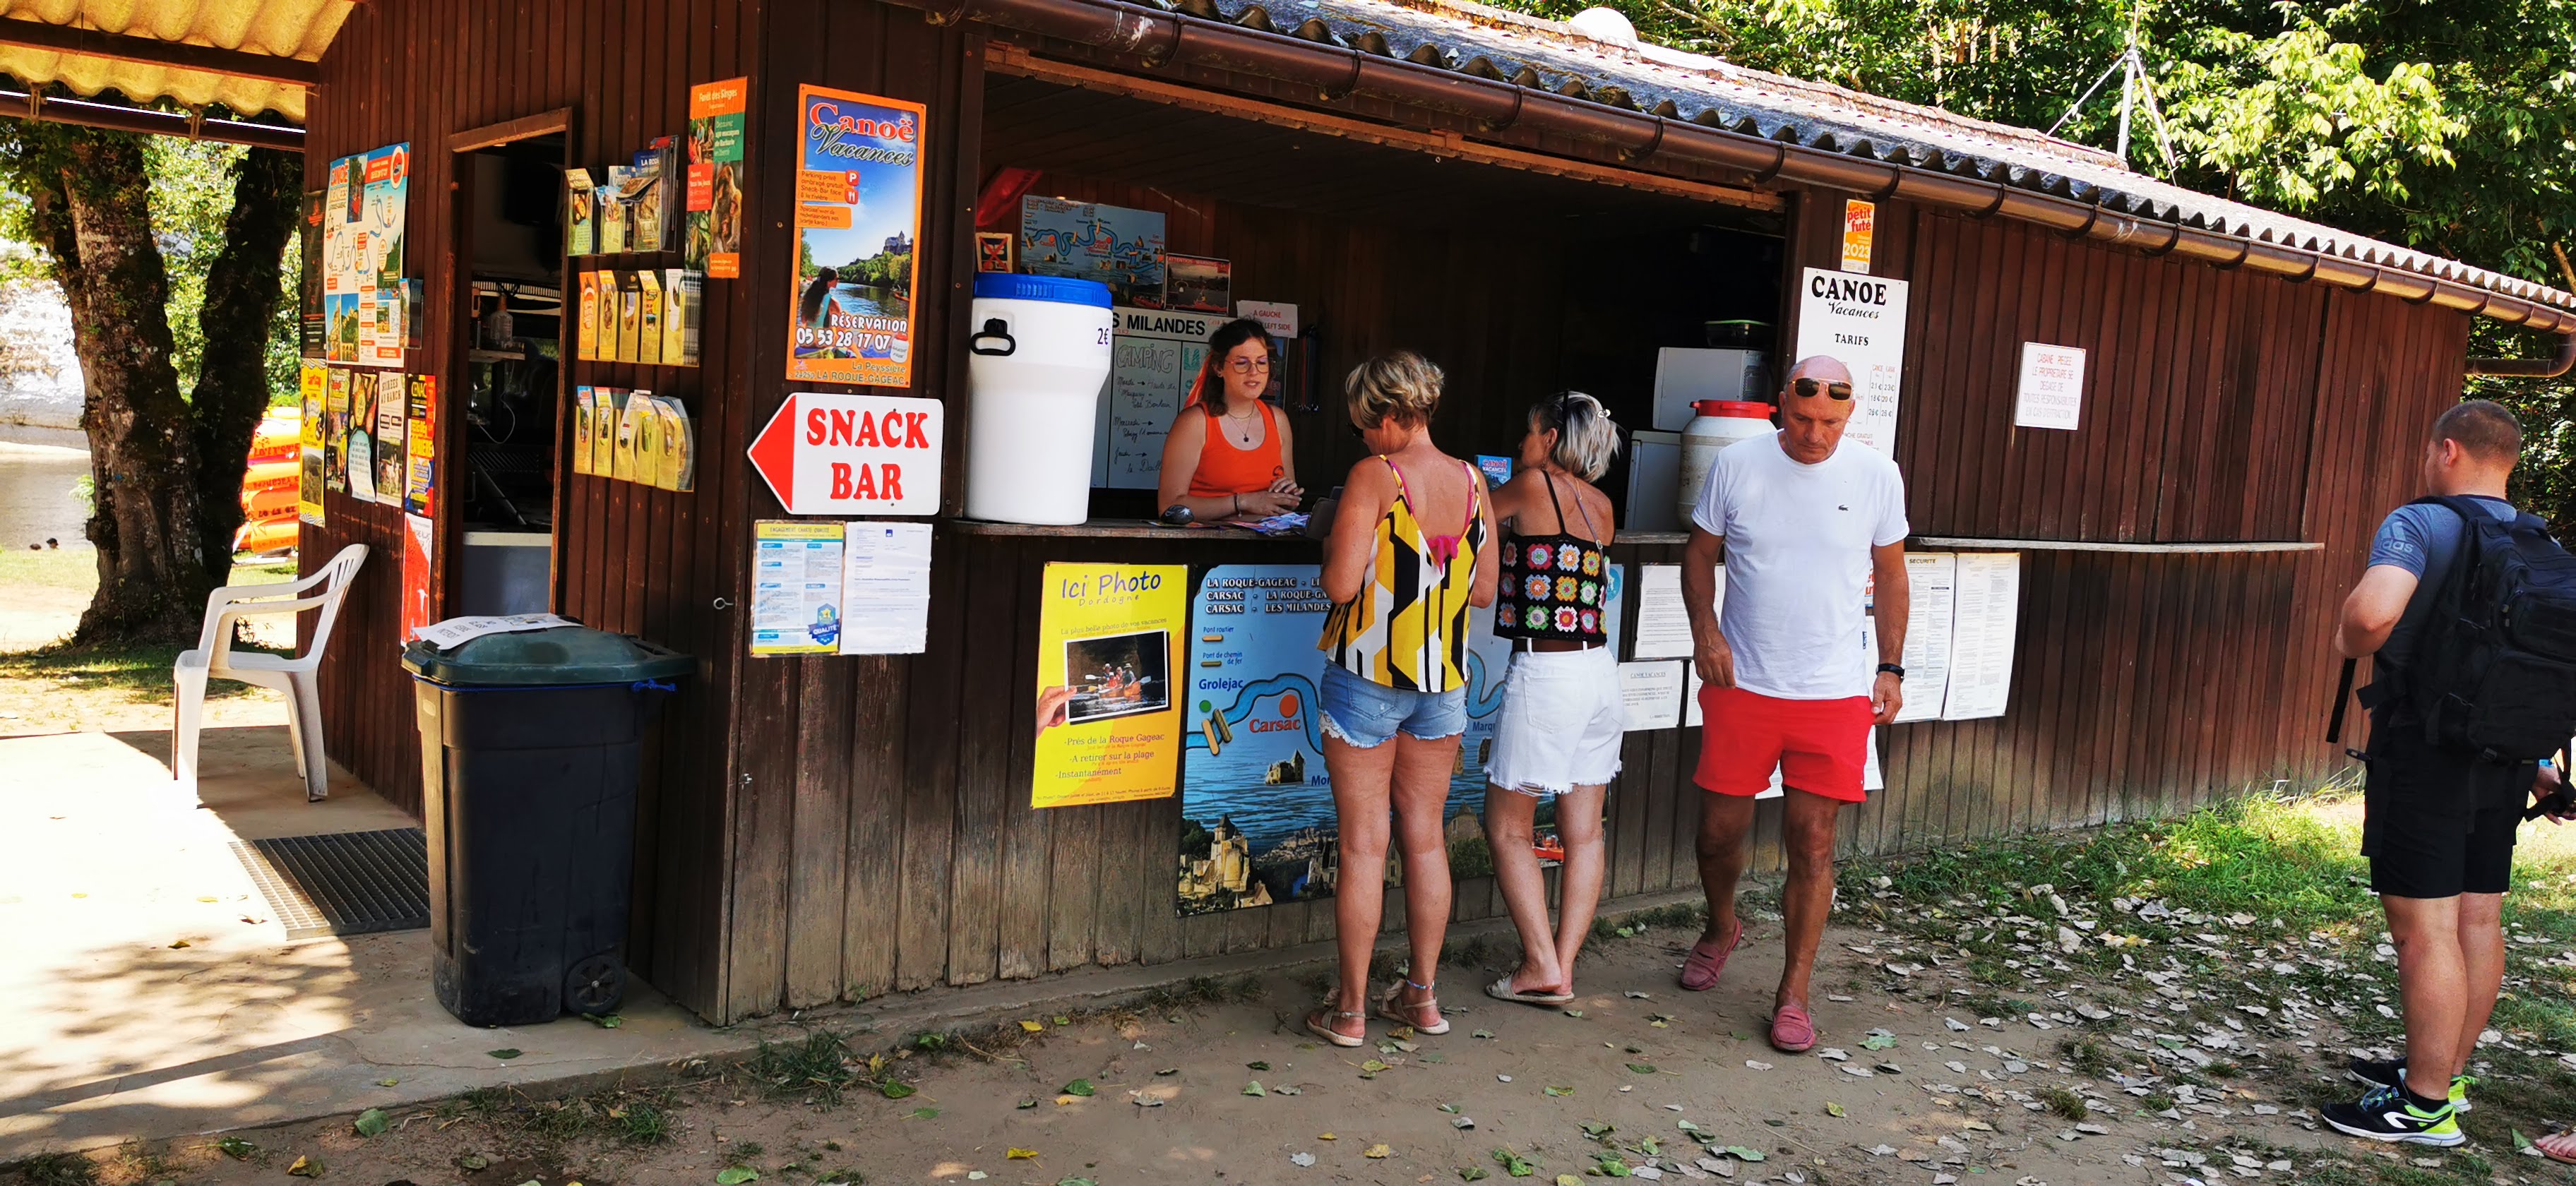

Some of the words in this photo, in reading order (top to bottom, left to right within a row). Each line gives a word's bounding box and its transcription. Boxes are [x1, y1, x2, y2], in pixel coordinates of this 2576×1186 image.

[810, 102, 914, 142] Canoë
[810, 123, 914, 167] Vacances
[801, 171, 822, 181] Parking
[1847, 207, 1871, 223] petit
[1852, 219, 1871, 232] futé
[1844, 242, 1871, 258] 2023
[1811, 275, 1888, 306] CANOE
[1259, 310, 1281, 318] GAUCHE
[1828, 301, 1880, 319] Vacances
[831, 311, 907, 333] RÉSERVATION
[1127, 315, 1206, 335] MILANDES
[1277, 323, 1292, 331] SIDE
[796, 328, 815, 345] 05
[817, 329, 835, 346] 53
[835, 331, 854, 347] 28
[857, 333, 873, 349] 17
[874, 334, 892, 351] 07
[1097, 328, 1109, 345] 2€
[1835, 333, 1869, 346] TARIFS
[852, 361, 863, 371] La
[865, 361, 906, 374] Peyssière
[816, 371, 828, 380] LA
[806, 407, 929, 449] SNACK
[830, 462, 903, 500] BAR
[1062, 575, 1088, 599] Ici
[1098, 570, 1162, 596] Photo
[1206, 577, 1219, 588] LA
[1222, 576, 1297, 589] ROQUE-GAGEAC
[1079, 594, 1140, 607] Dordogne
[1205, 590, 1246, 601] CARSAC
[1265, 590, 1278, 599] LA
[1280, 589, 1328, 599] ROQUE-GA
[1205, 603, 1245, 615] CARSAC
[1265, 603, 1283, 613] LES
[1285, 601, 1332, 612] MILANDES
[1071, 627, 1084, 635] plus
[1085, 624, 1101, 633] belle
[1102, 623, 1119, 633] photo
[1141, 617, 1167, 626] vacances
[1234, 657, 1243, 666] fer
[1198, 677, 1244, 692] Grolejac
[1248, 718, 1301, 733] Carsac
[1109, 735, 1134, 745] Roque
[1136, 733, 1165, 743] Gageac
[1080, 754, 1108, 762] retirer
[1124, 751, 1132, 760] la
[1133, 750, 1155, 761] plage
